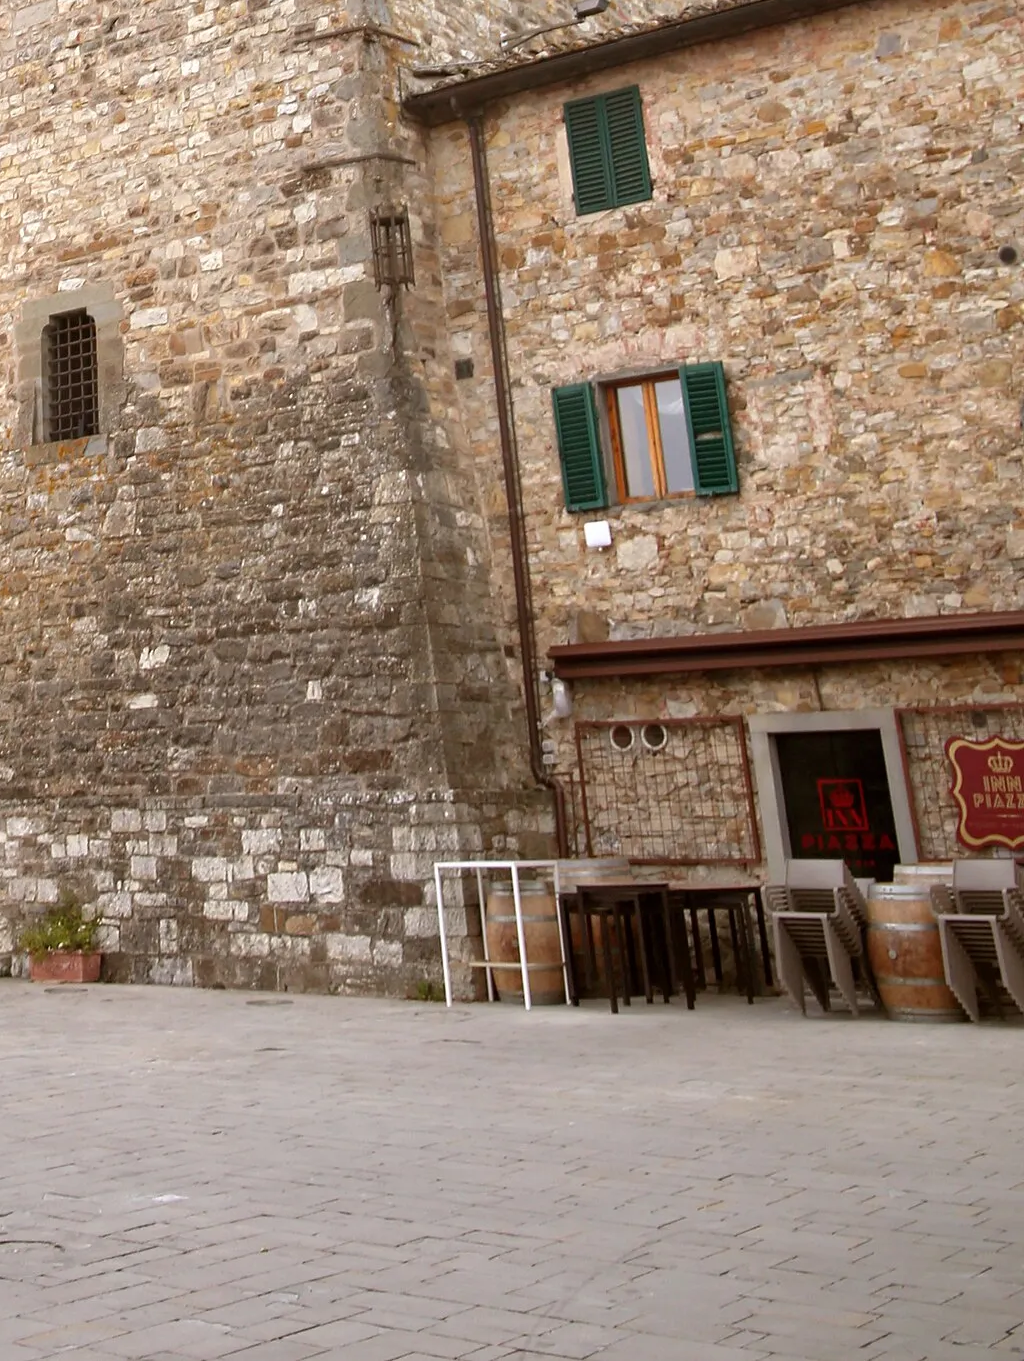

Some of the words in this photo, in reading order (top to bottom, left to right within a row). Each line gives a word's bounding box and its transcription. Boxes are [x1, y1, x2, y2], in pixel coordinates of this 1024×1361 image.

[983, 775, 1022, 792] INN
[827, 809, 862, 827] INN
[801, 832, 894, 851] PIAZZA
